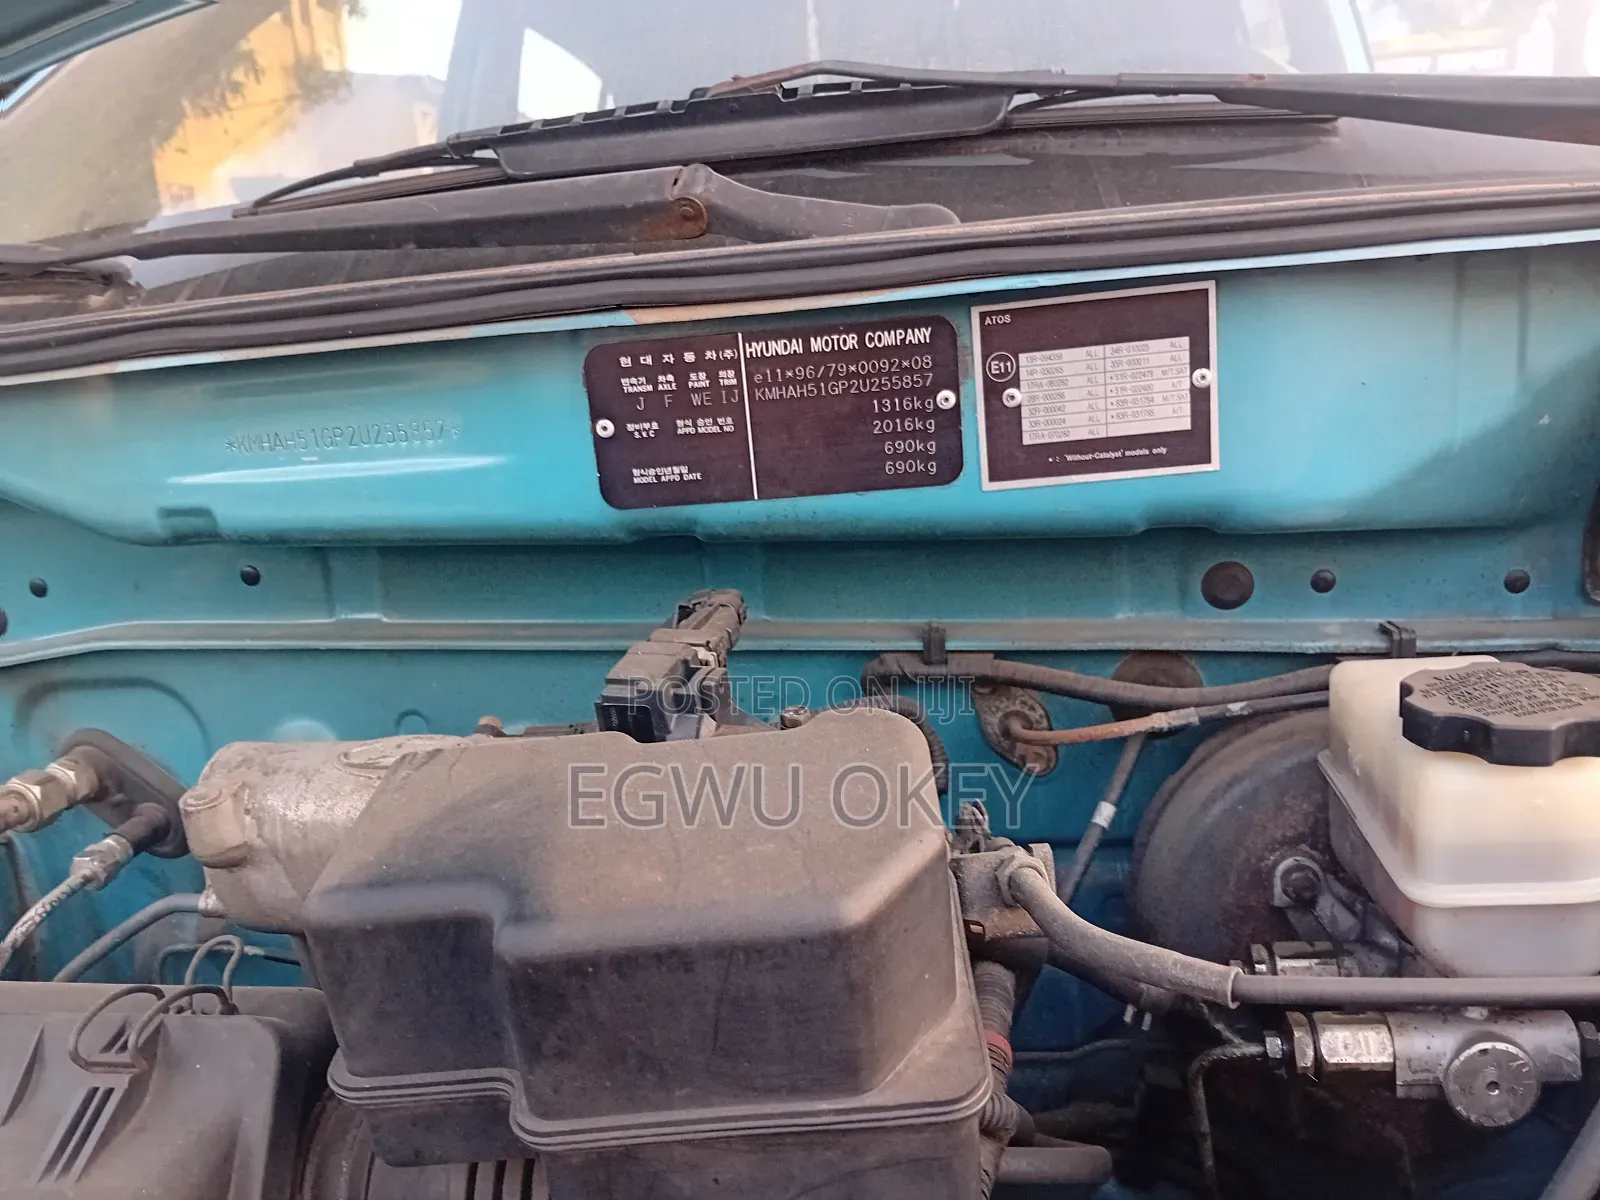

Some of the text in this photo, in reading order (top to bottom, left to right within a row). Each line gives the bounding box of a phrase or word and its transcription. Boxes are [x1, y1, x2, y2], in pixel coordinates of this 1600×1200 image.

[984, 314, 1011, 326] ATOS
[746, 327, 932, 358] HYUNDAI MOTOR COMPANY
[991, 361, 1011, 374] E11
[623, 378, 737, 394] TRANSM AXLE PAINT TRIM
[755, 373, 933, 401] KMHAH51GP2U255857
[636, 397, 645, 411] J
[664, 394, 673, 408] F
[873, 396, 934, 413] 1316kg
[698, 426, 722, 434] MODEL
[872, 417, 935, 434] 2016kg
[884, 439, 936, 454] 690kg
[1125, 448, 1149, 456] models
[1152, 446, 1167, 454] only
[885, 460, 936, 475] 690kg
[633, 476, 658, 484] MODEL
[683, 473, 702, 481] DATE
